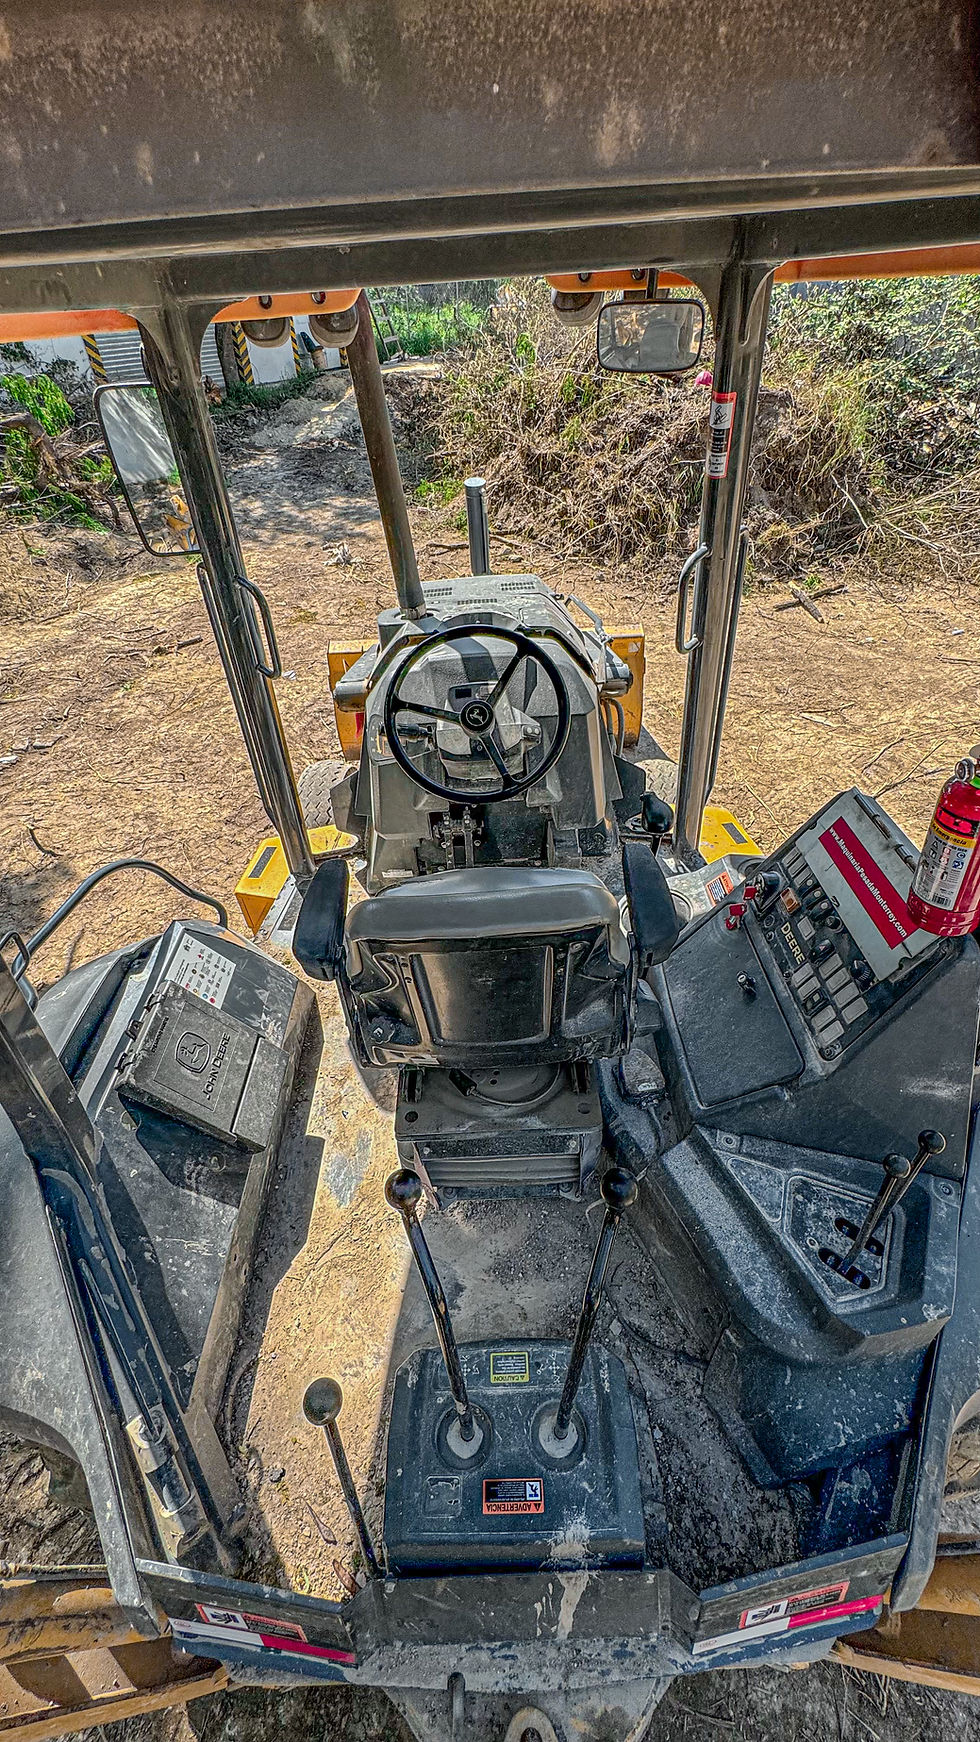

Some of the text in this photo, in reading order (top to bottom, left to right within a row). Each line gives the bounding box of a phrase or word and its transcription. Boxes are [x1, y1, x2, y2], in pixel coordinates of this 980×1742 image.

[936, 828, 968, 846] Emergncia
[829, 827, 908, 939] www.MaquinariaPesadaMonterrey.com
[780, 921, 805, 964] DEERE
[202, 1033, 231, 1100] JOHN DEERE
[486, 1503, 532, 1512] ADVERTENCIA
